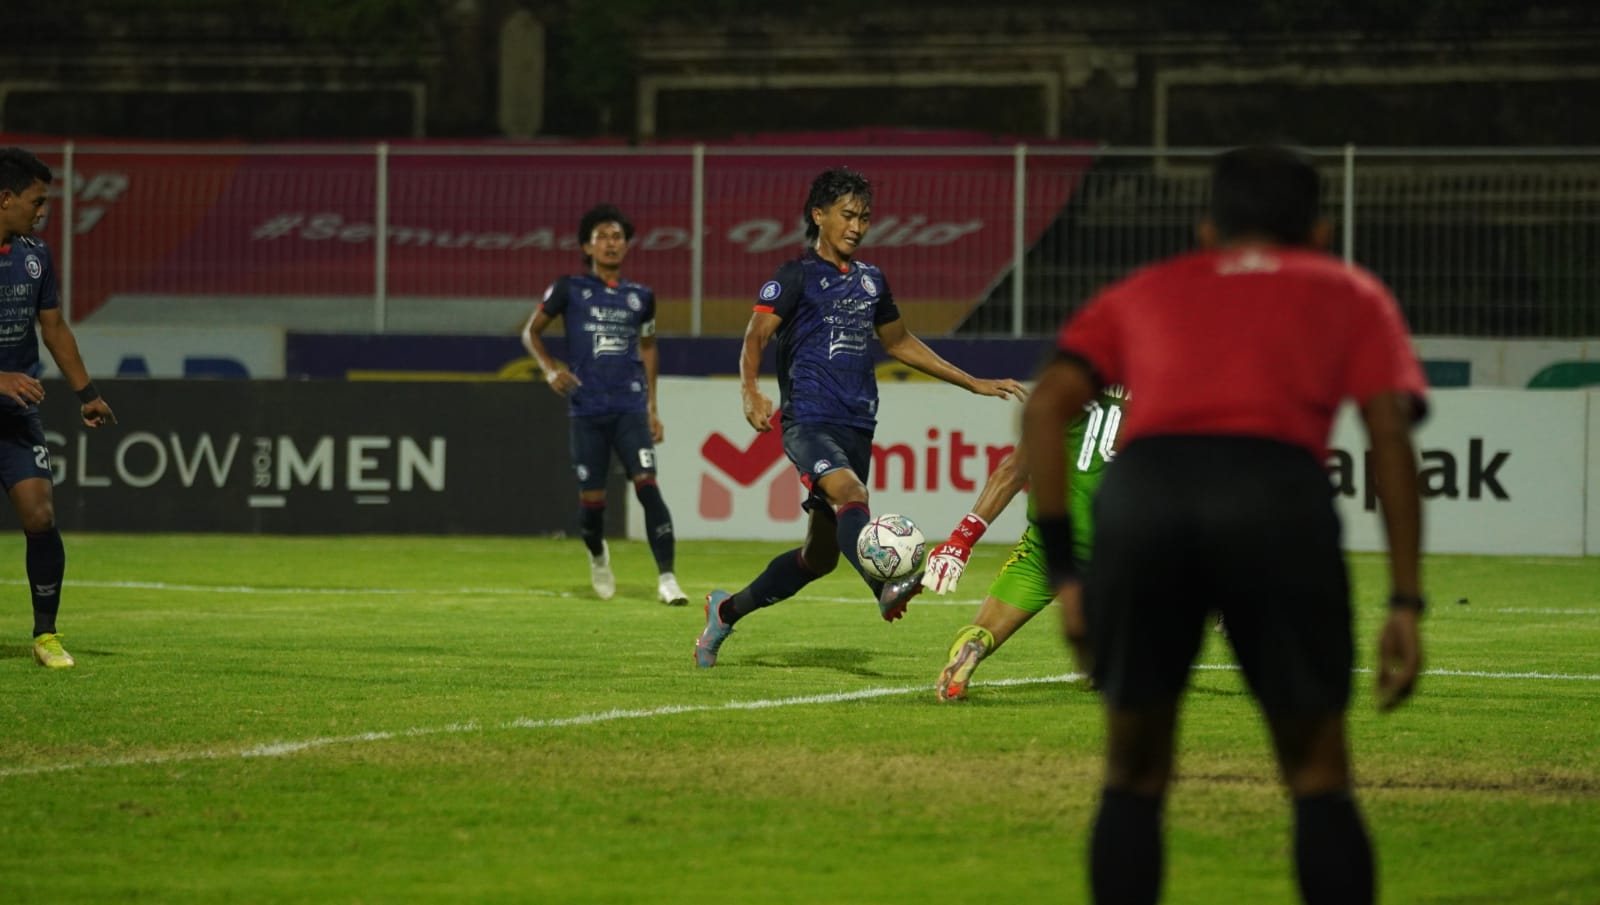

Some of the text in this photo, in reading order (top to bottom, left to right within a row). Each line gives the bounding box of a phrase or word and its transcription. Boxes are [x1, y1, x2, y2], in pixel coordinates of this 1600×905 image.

[43, 431, 447, 492] GLOW FOR MEN
[871, 428, 1029, 492] mitr
